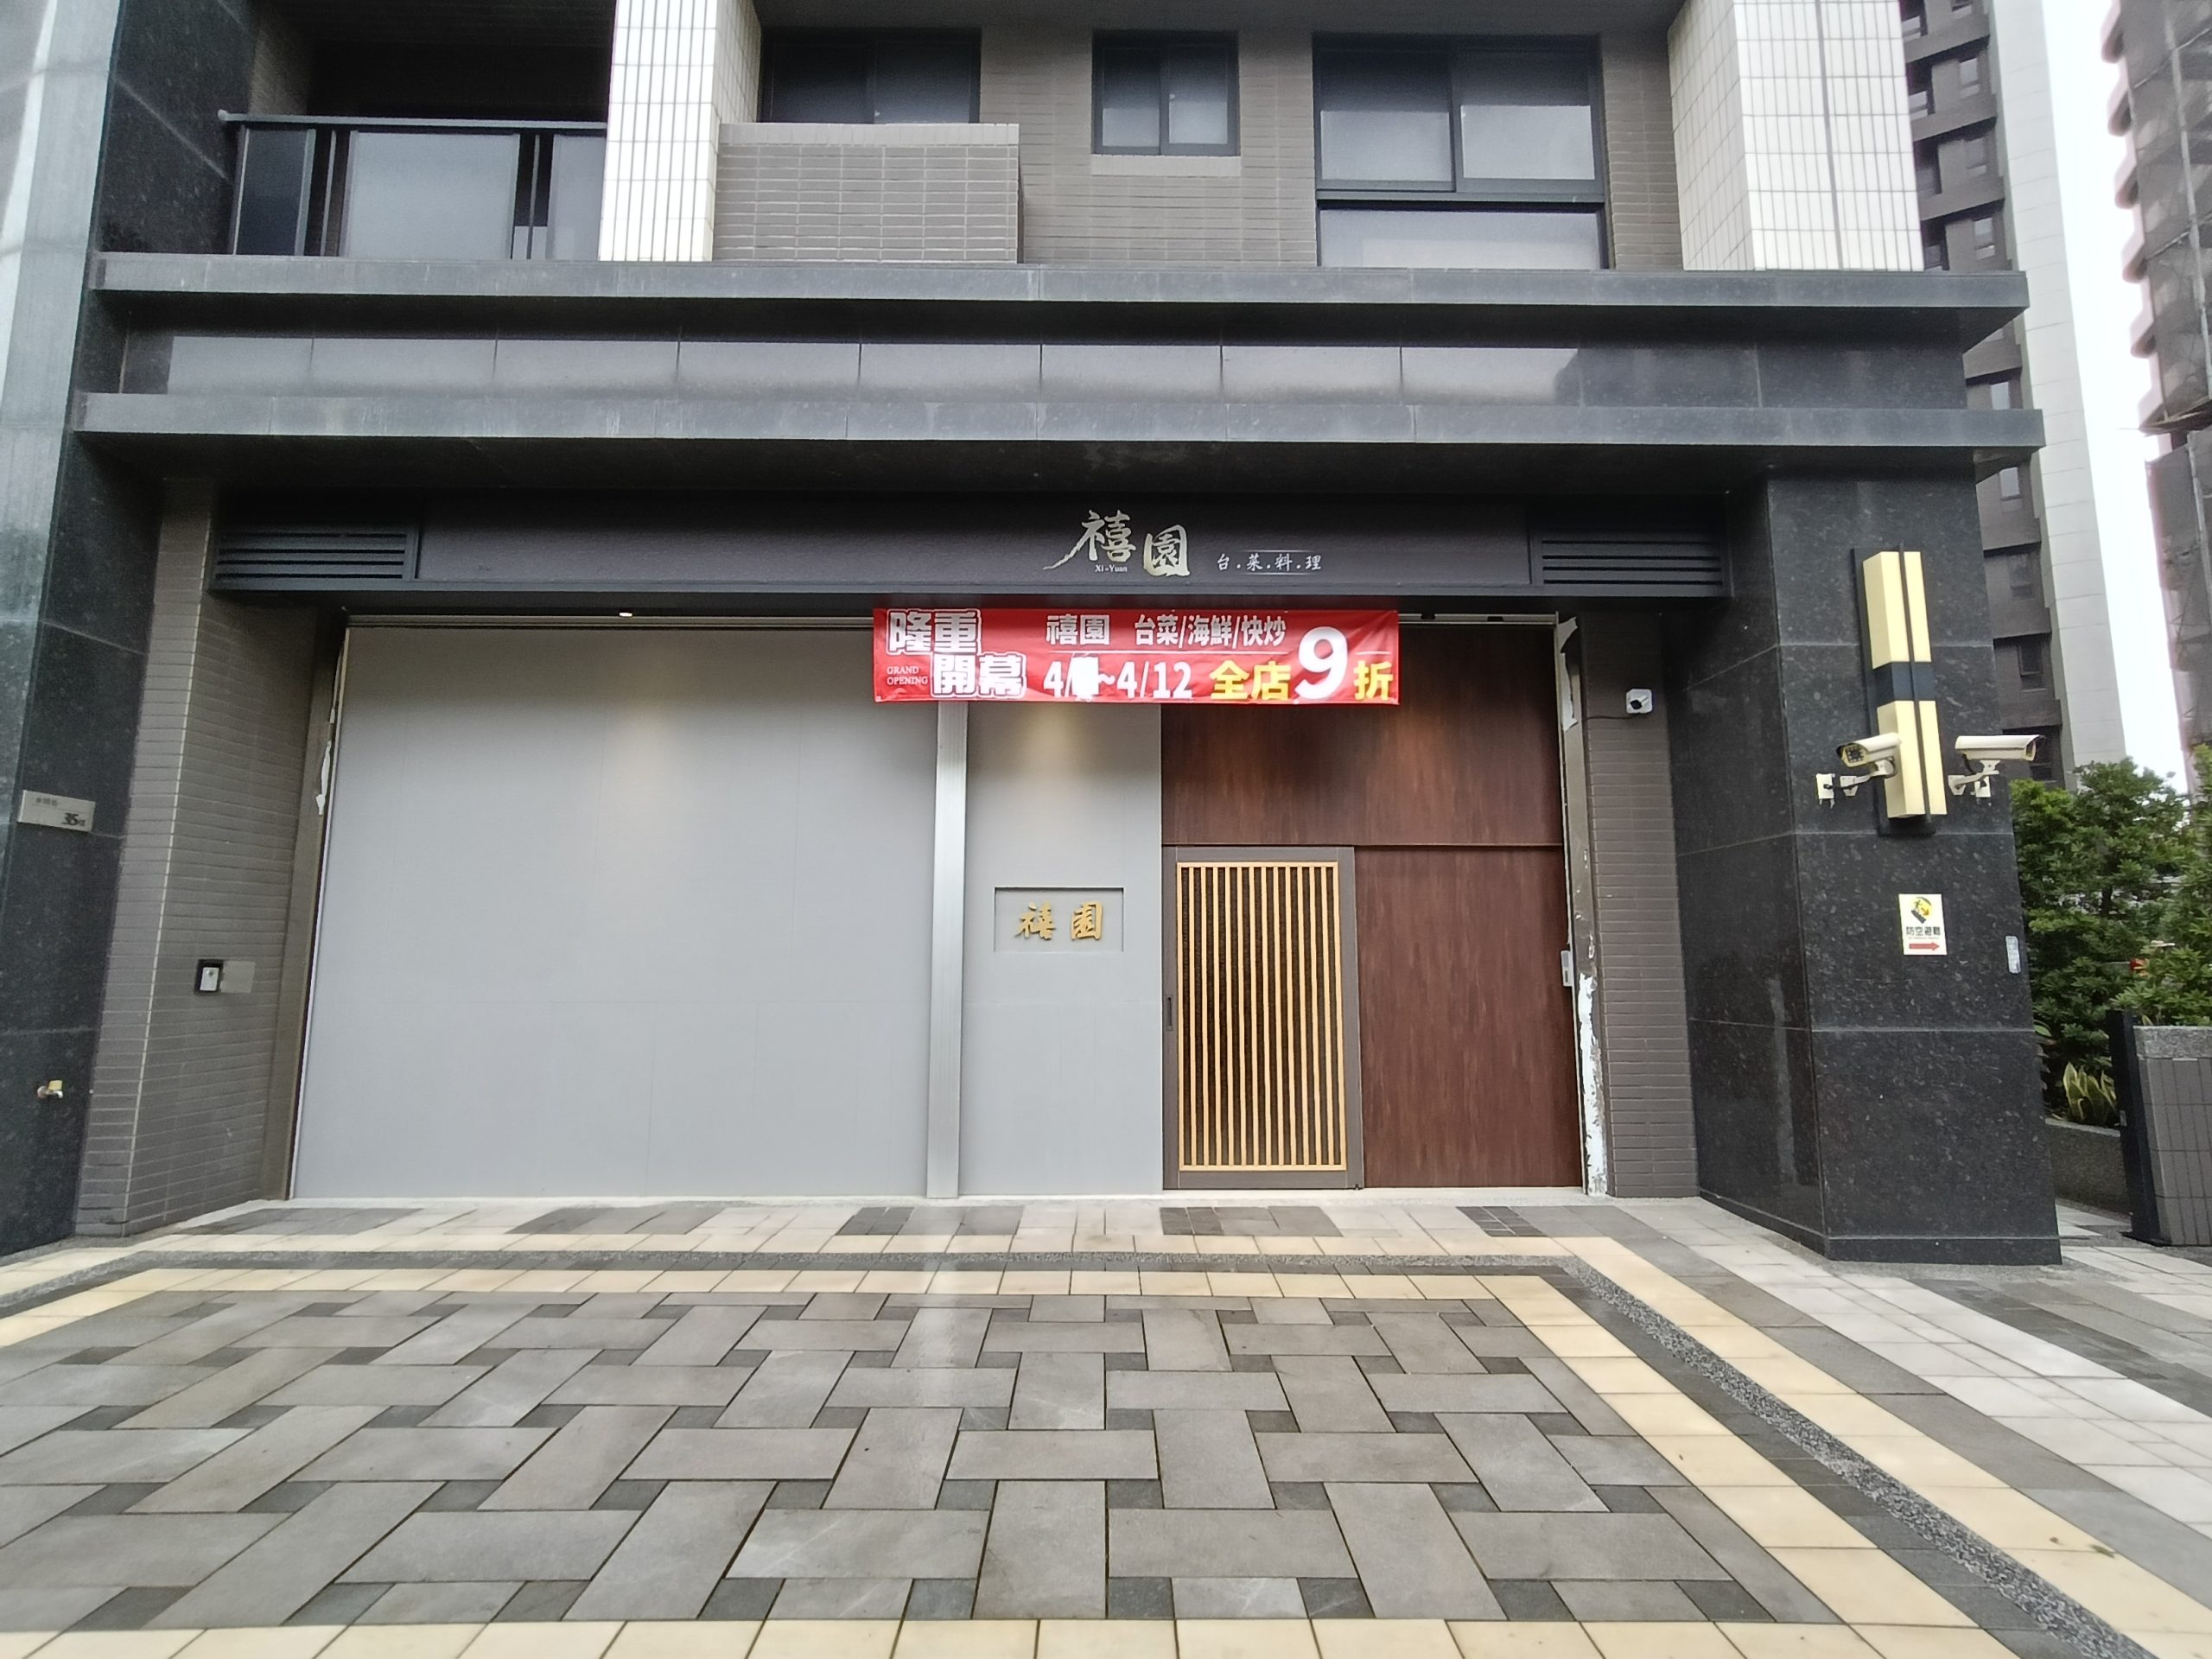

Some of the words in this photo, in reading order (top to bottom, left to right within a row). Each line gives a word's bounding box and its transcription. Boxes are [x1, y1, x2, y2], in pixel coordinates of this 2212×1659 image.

[1043, 509, 1190, 577] 禧園
[888, 610, 979, 654] 隆重
[1046, 614, 1110, 645] 禧園
[1135, 613, 1287, 648] 台菜/海鮮/快炒
[887, 665, 919, 675] GRAND
[887, 676, 928, 685] OPENING
[932, 652, 1027, 697] 開幕
[1043, 660, 1192, 699] 4/~4/12
[1015, 900, 1103, 941] 禧園
